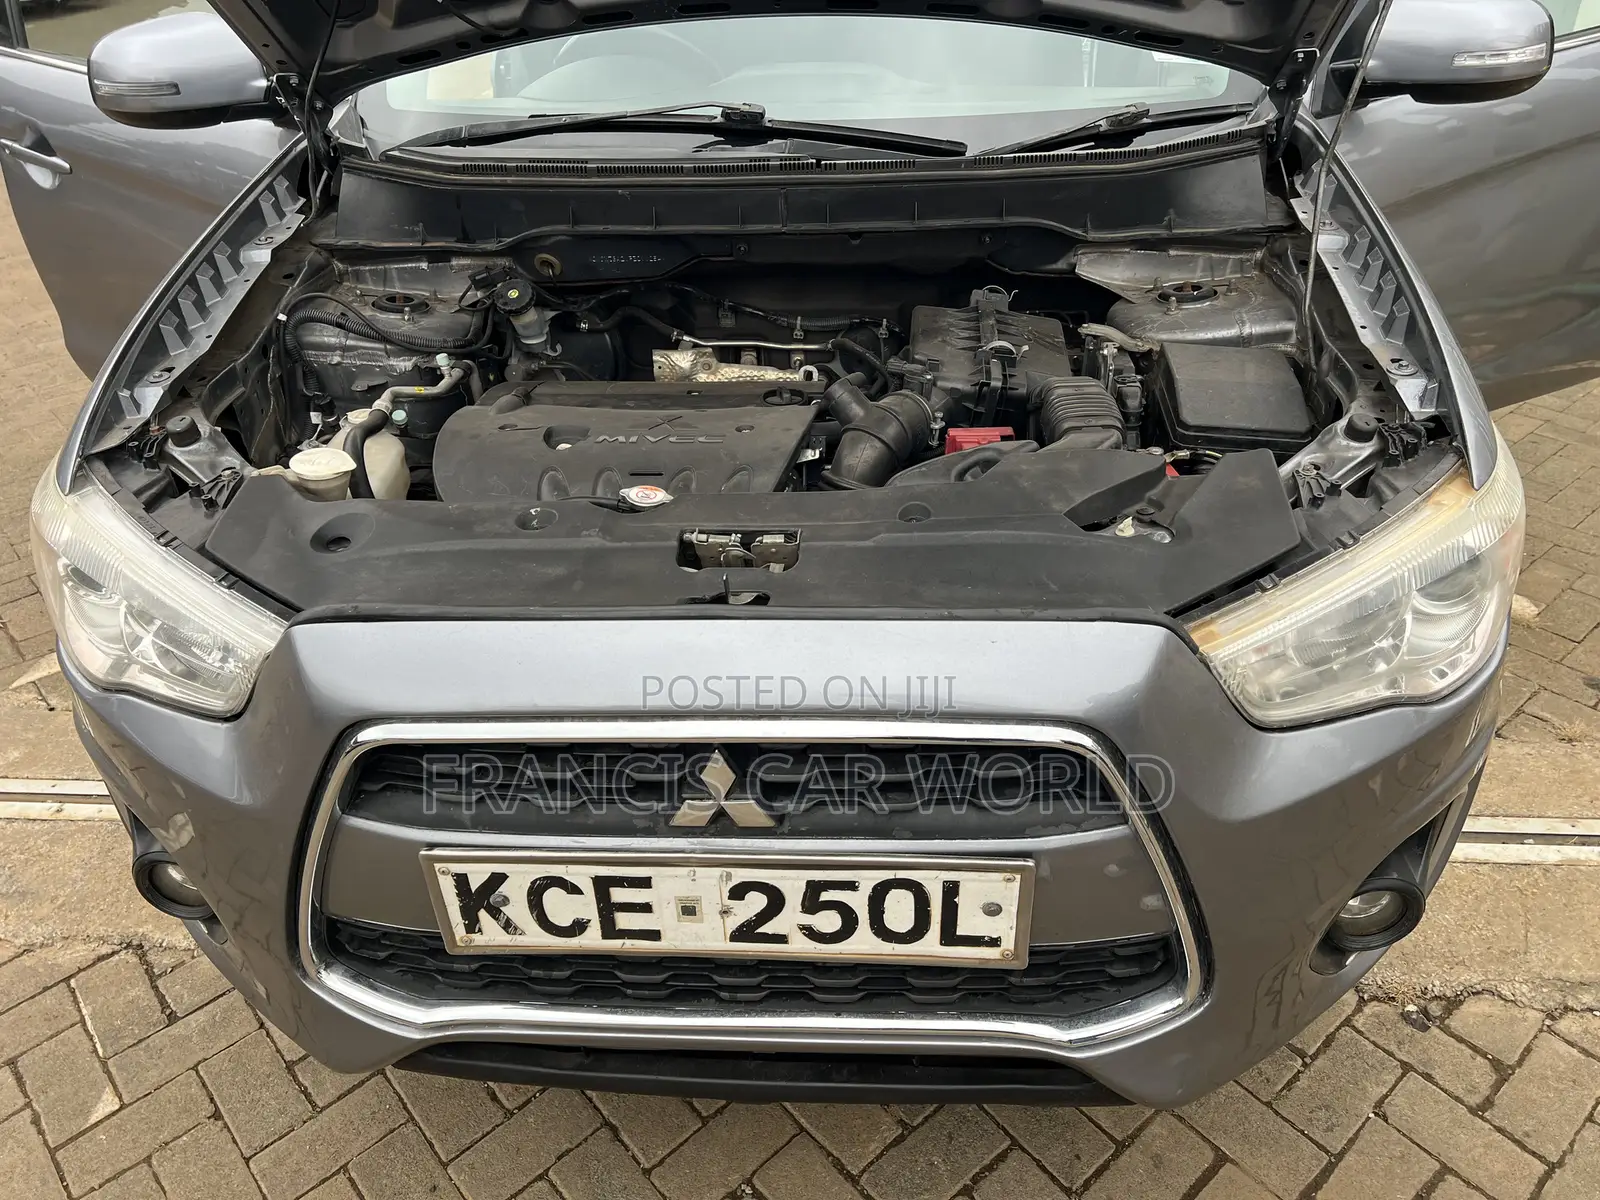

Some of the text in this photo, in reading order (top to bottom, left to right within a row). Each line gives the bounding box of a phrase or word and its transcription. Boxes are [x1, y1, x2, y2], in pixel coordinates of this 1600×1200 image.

[594, 432, 727, 444] MIVEC
[450, 871, 1002, 947] KCE 250L
